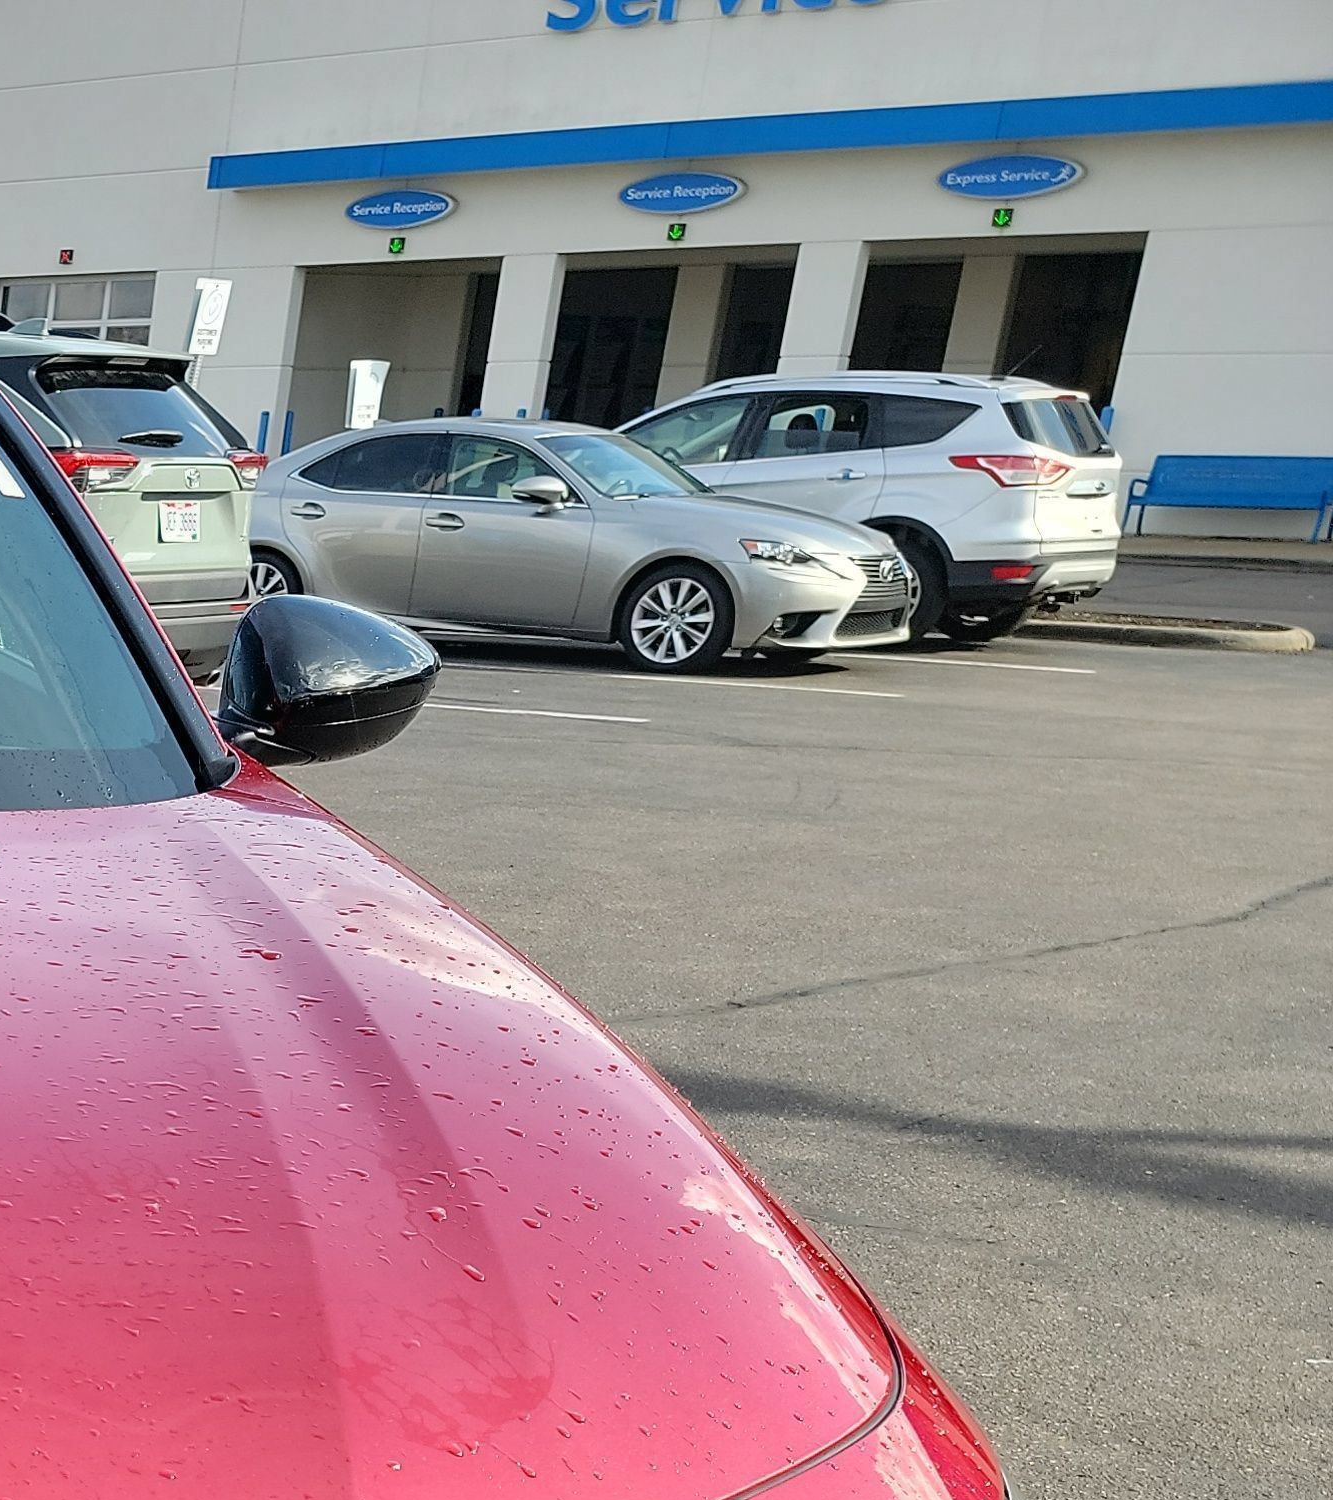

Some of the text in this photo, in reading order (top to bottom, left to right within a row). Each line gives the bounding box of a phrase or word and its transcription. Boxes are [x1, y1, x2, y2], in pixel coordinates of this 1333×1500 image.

[946, 169, 1049, 187] Express Service
[626, 184, 734, 200] Service Reception
[353, 201, 446, 216] Service Reception
